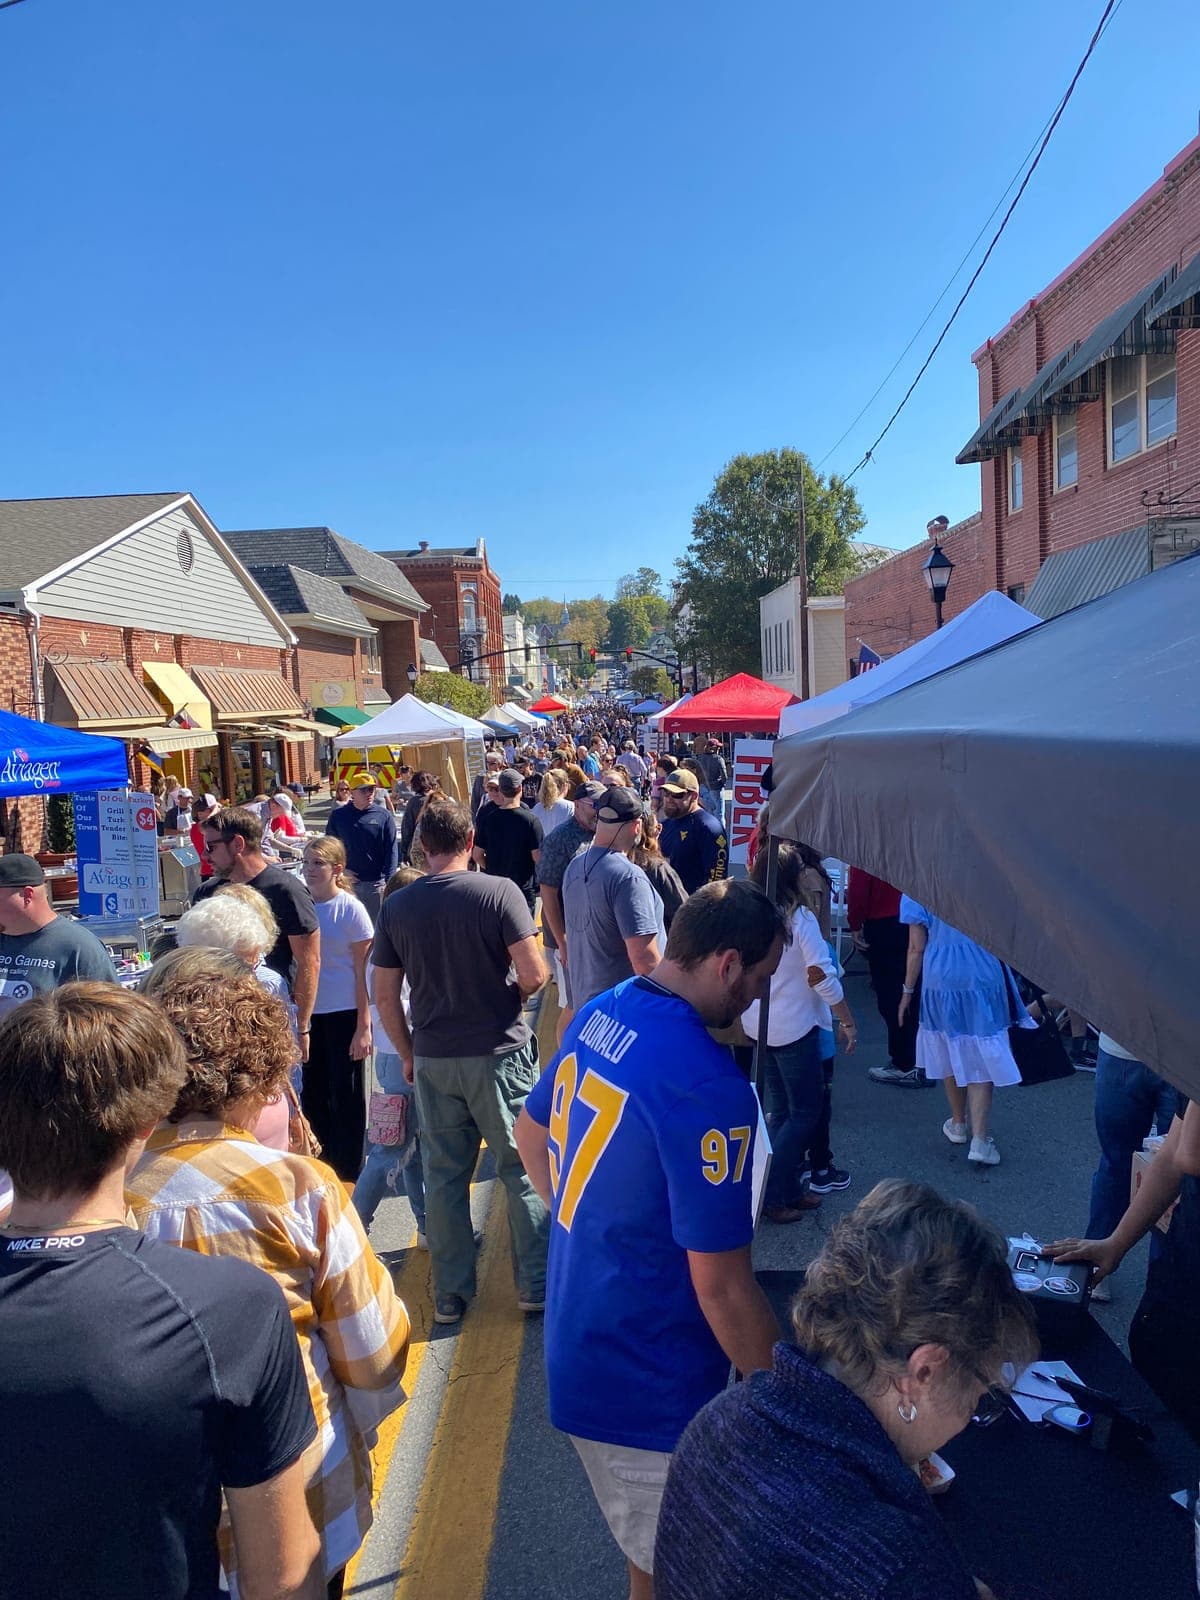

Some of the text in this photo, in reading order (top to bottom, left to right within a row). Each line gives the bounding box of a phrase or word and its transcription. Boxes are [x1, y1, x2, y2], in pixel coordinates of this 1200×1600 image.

[0, 750, 59, 789] Aviagen
[74, 794, 96, 802] Taste
[76, 823, 98, 831] Town
[139, 812, 154, 827] $4
[15, 954, 56, 969] Games
[577, 1008, 639, 1064] DONALD
[547, 1052, 630, 1233] 97
[700, 1125, 752, 1186] 97
[6, 1235, 86, 1251] NIKE PRO
